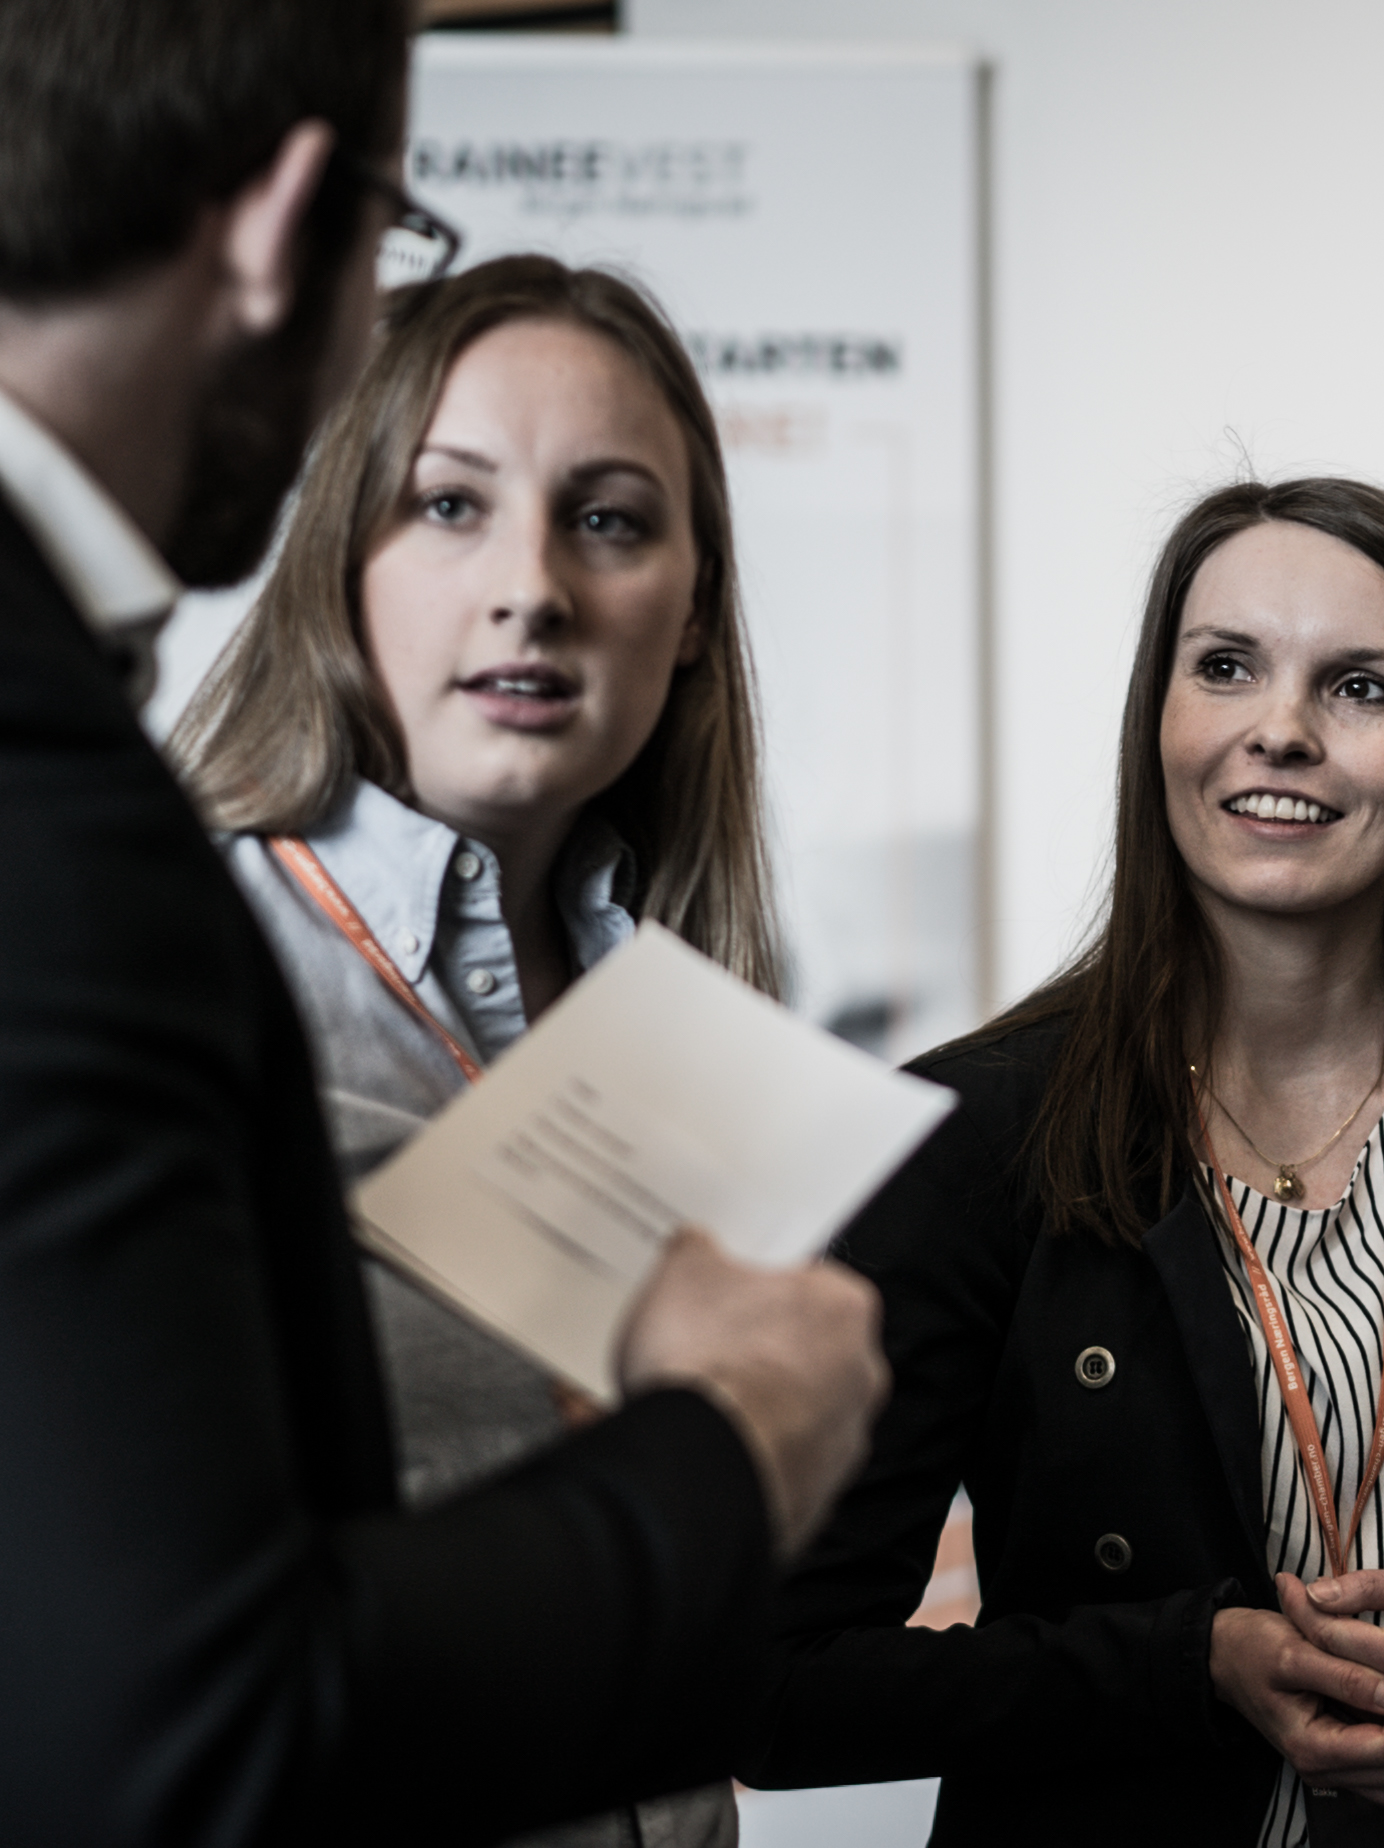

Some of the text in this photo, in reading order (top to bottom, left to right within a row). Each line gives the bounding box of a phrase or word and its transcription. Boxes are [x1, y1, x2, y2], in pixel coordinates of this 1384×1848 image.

[412, 139, 752, 181] RAINEEVEST
[1257, 1284, 1286, 1348] Næringsråd
[1279, 1349, 1298, 1391] Bergen
